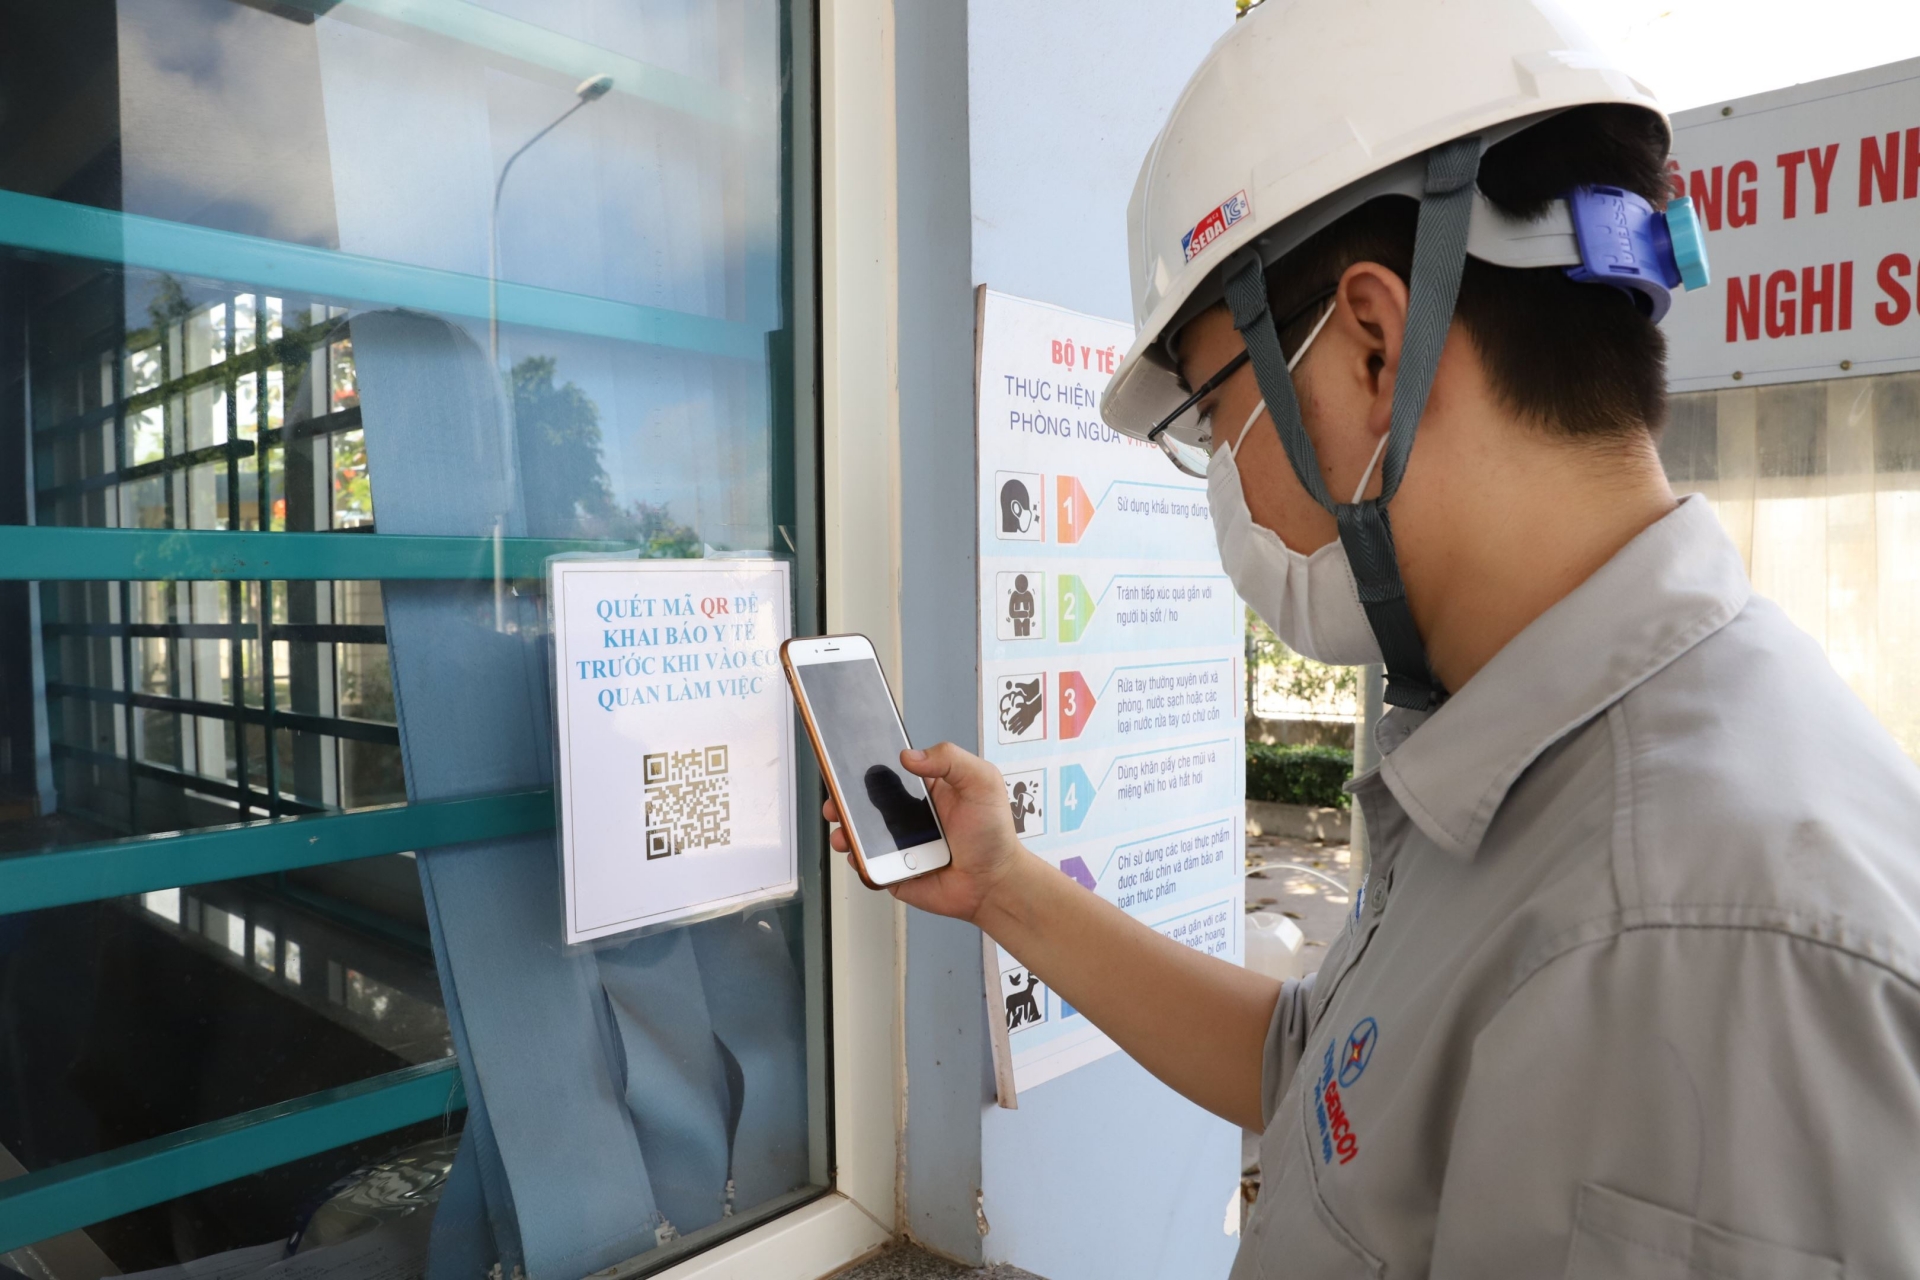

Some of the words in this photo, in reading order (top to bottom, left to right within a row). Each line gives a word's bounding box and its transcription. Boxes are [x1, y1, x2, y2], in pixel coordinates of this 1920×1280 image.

[1776, 142, 1841, 220] TY
[1185, 219, 1225, 261] SSEDA
[1725, 260, 1854, 343] NGHI
[1874, 253, 1920, 327] S
[1051, 338, 1075, 372] BỘ
[1080, 346, 1091, 370] Y
[1096, 345, 1116, 375] TẾ
[1004, 375, 1051, 403] THỰC
[1057, 382, 1095, 410] HIỆN
[1010, 410, 1071, 438] PHÒNG
[1063, 497, 1072, 524] 1
[1117, 496, 1128, 512] Sử
[1131, 498, 1149, 516] dụng
[1171, 502, 1189, 518] trang
[1191, 503, 1208, 520] đúng
[1063, 593, 1076, 620] 2
[1117, 585, 1139, 601] Tránh
[1141, 584, 1155, 603] tiếp
[1157, 586, 1170, 600] xúc
[1172, 587, 1186, 603] quá
[1202, 586, 1212, 599] với
[596, 594, 656, 622] QUÉT
[663, 594, 695, 616] MÃ
[701, 597, 729, 618] QR
[1116, 609, 1139, 627] người
[1140, 609, 1148, 625] bị
[1150, 607, 1162, 623] sốt
[1169, 608, 1178, 622] ho
[603, 628, 659, 648] KHAI
[665, 621, 708, 645] BÁO
[713, 625, 726, 642] Y
[576, 653, 656, 680] TRƯỚC
[662, 654, 700, 674] KHI
[705, 647, 747, 670] VÀO
[598, 685, 660, 712] QUAN
[666, 678, 711, 702] LÀM
[717, 675, 763, 700] VIỆC
[1117, 677, 1133, 694] Rửa
[1135, 678, 1147, 694] tay
[1149, 675, 1174, 691] thường
[1176, 673, 1197, 689] xuyên
[1064, 688, 1077, 717] 3
[1146, 694, 1165, 710] nước
[1167, 693, 1184, 709] sạch
[1186, 691, 1203, 706] hoặc
[1205, 689, 1218, 703] các
[1117, 718, 1131, 735] loại
[1133, 716, 1153, 731] nước
[1155, 713, 1166, 728] rửa
[1168, 712, 1180, 728] tay
[1181, 710, 1191, 724] có
[1117, 765, 1138, 781] Dùng
[1140, 760, 1159, 779] khăn
[1160, 755, 1176, 775] giấy
[1177, 755, 1191, 769] che
[1207, 750, 1216, 763] và
[1064, 782, 1078, 811] 4
[1117, 783, 1142, 800] miệng
[1143, 779, 1155, 795] khi
[1157, 779, 1166, 792] ho
[1169, 776, 1177, 789] và
[1192, 770, 1203, 784] hơi
[1145, 846, 1164, 863] dụng
[1165, 842, 1179, 857] các
[1180, 839, 1193, 854] loại
[1195, 835, 1210, 849] thực
[1118, 873, 1138, 890] được
[1140, 866, 1154, 884] nấu
[1155, 863, 1172, 879] chín
[1173, 862, 1182, 874] và
[1215, 850, 1224, 861] an
[1117, 892, 1135, 909] toàn
[1137, 888, 1154, 905] thực
[1173, 924, 1187, 940] quá
[1214, 911, 1227, 923] các
[1205, 927, 1225, 942] hoang
[1215, 940, 1227, 952] ốm
